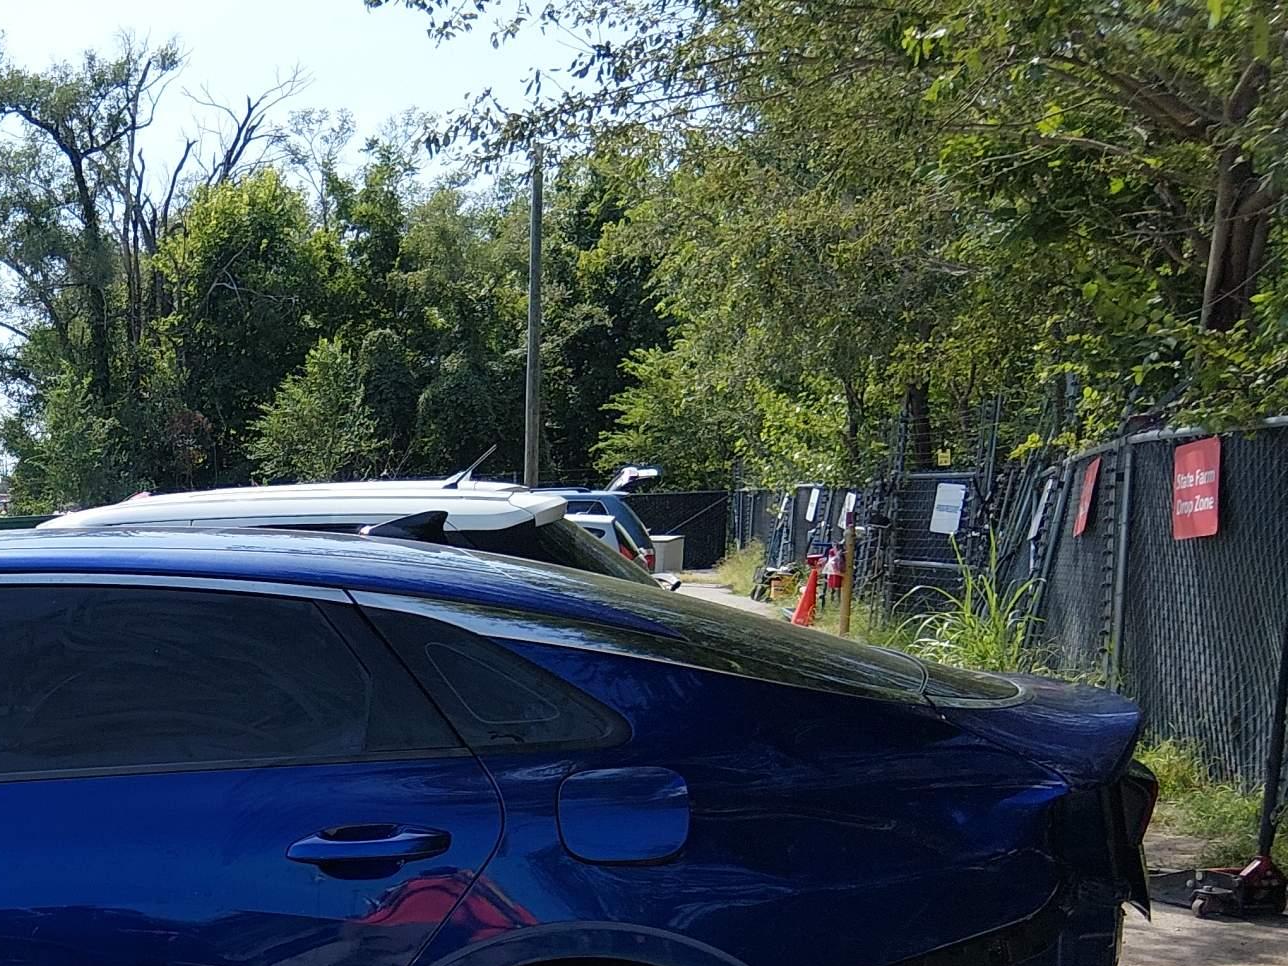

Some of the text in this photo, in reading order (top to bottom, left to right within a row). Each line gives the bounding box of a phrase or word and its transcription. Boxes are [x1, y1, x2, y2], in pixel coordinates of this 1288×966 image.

[1175, 469, 1216, 490] State Farm
[1175, 494, 1215, 517] Drop Zone
